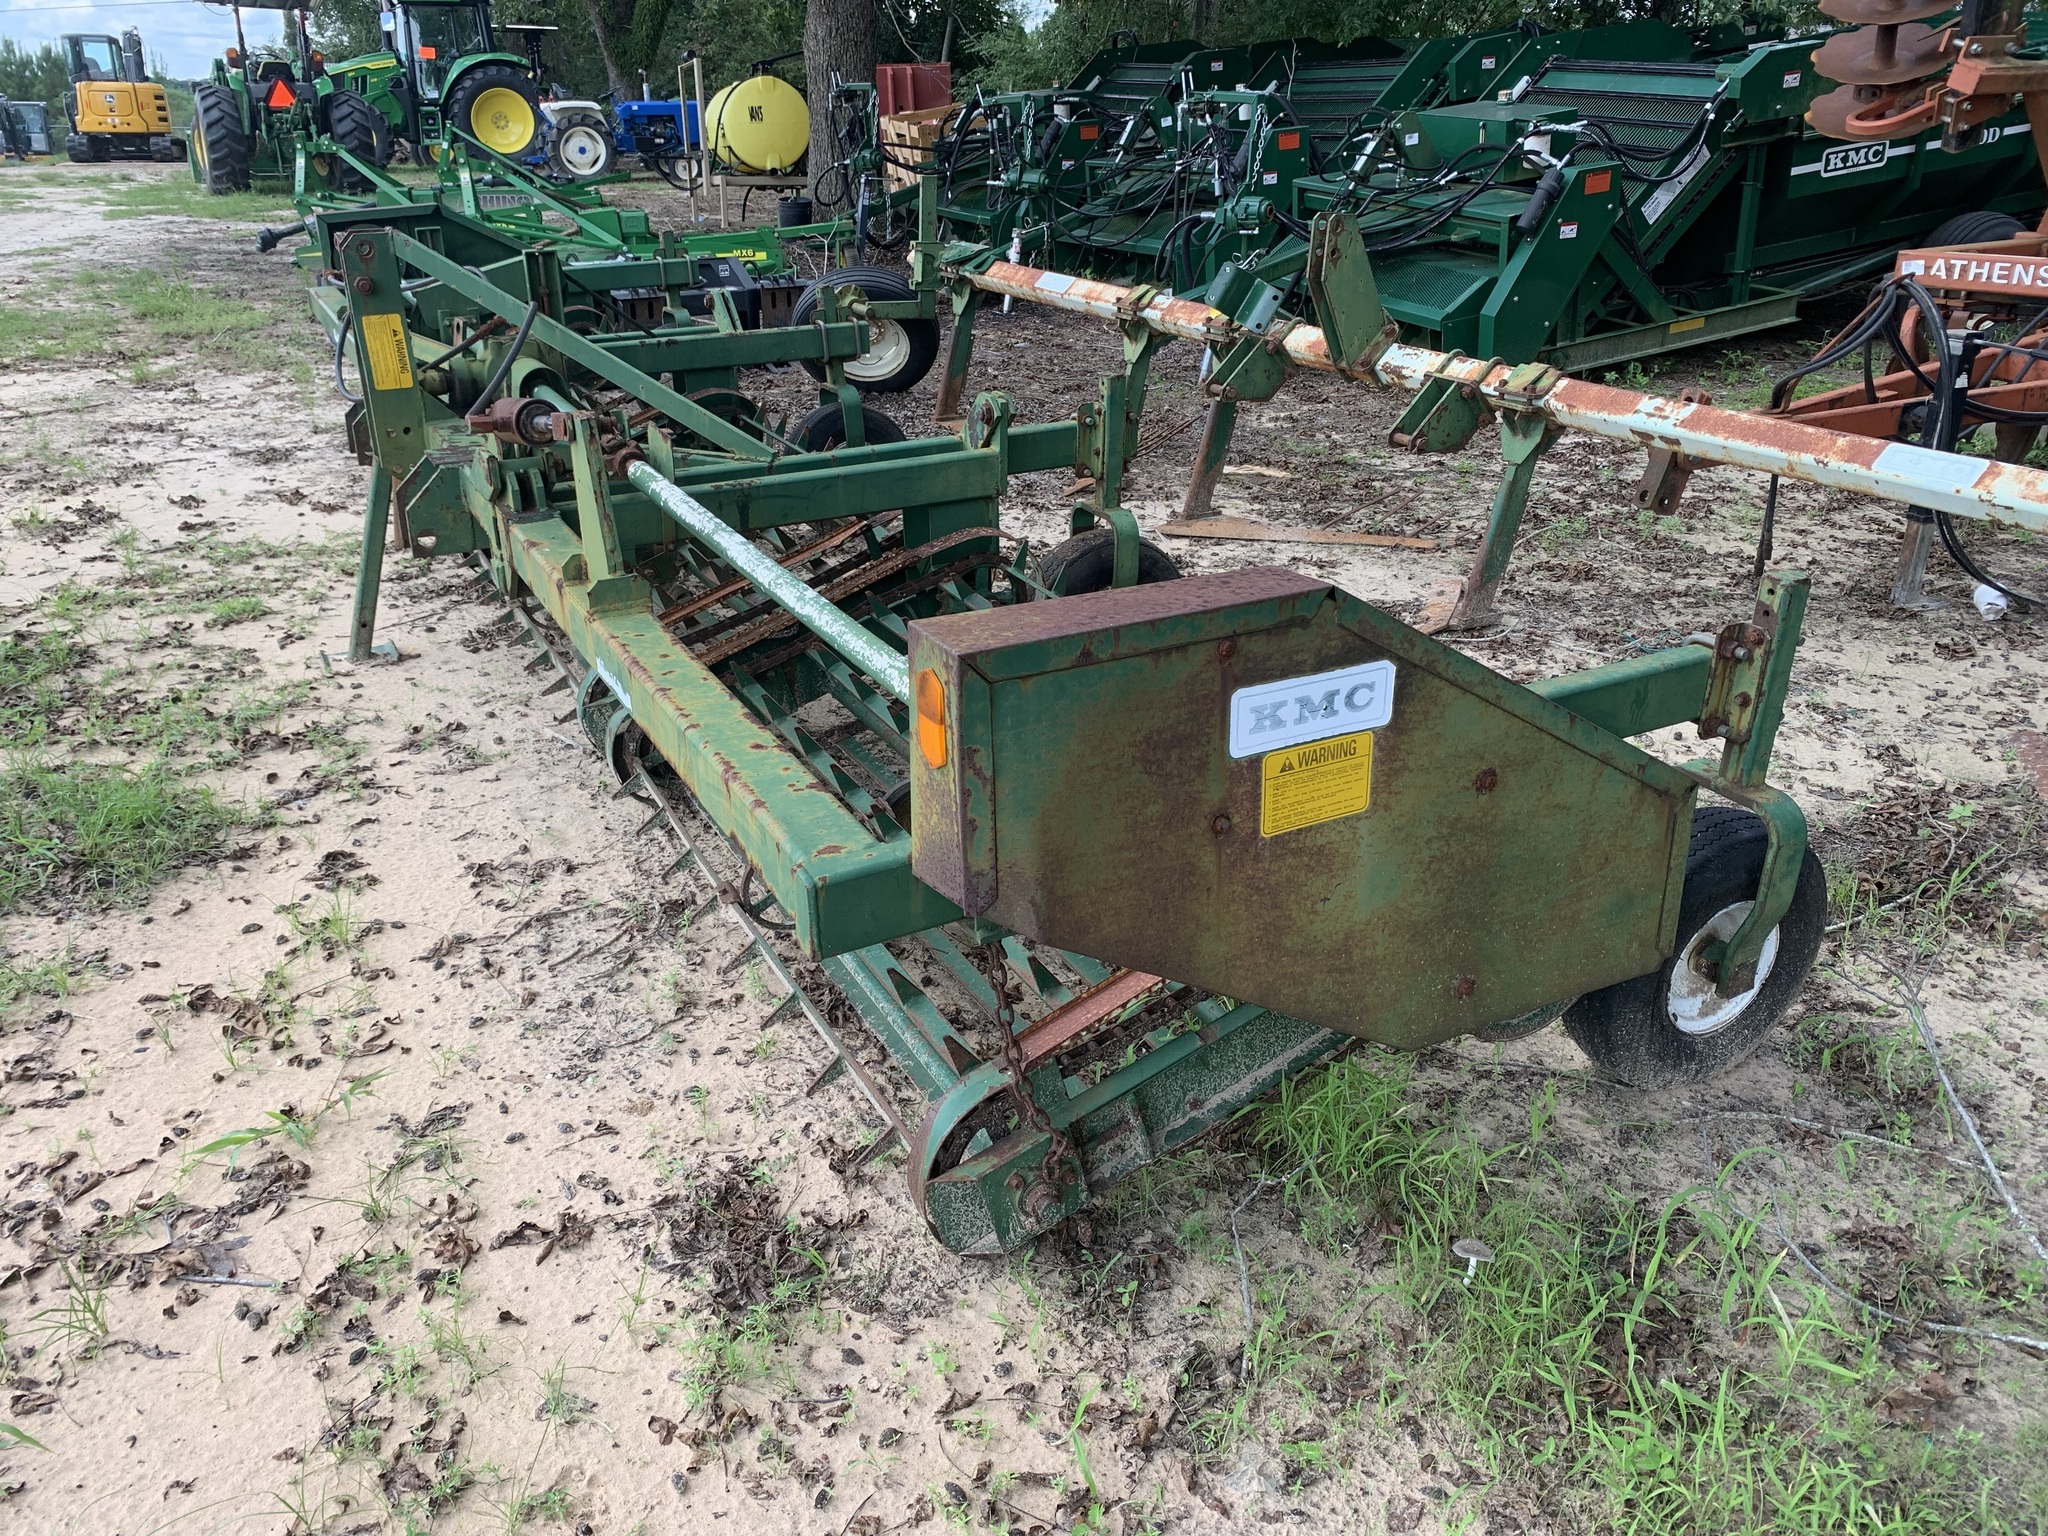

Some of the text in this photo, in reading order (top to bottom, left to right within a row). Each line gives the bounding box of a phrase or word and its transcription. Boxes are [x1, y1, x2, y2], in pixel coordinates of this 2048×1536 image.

[1827, 145, 1883, 170] KMC
[478, 195, 531, 209] HINO
[732, 249, 754, 257] MX6
[1929, 258, 2048, 287] ATHENS
[394, 338, 410, 374] WARNING
[1249, 681, 1376, 735] KMC
[1297, 739, 1357, 768] WARNING
